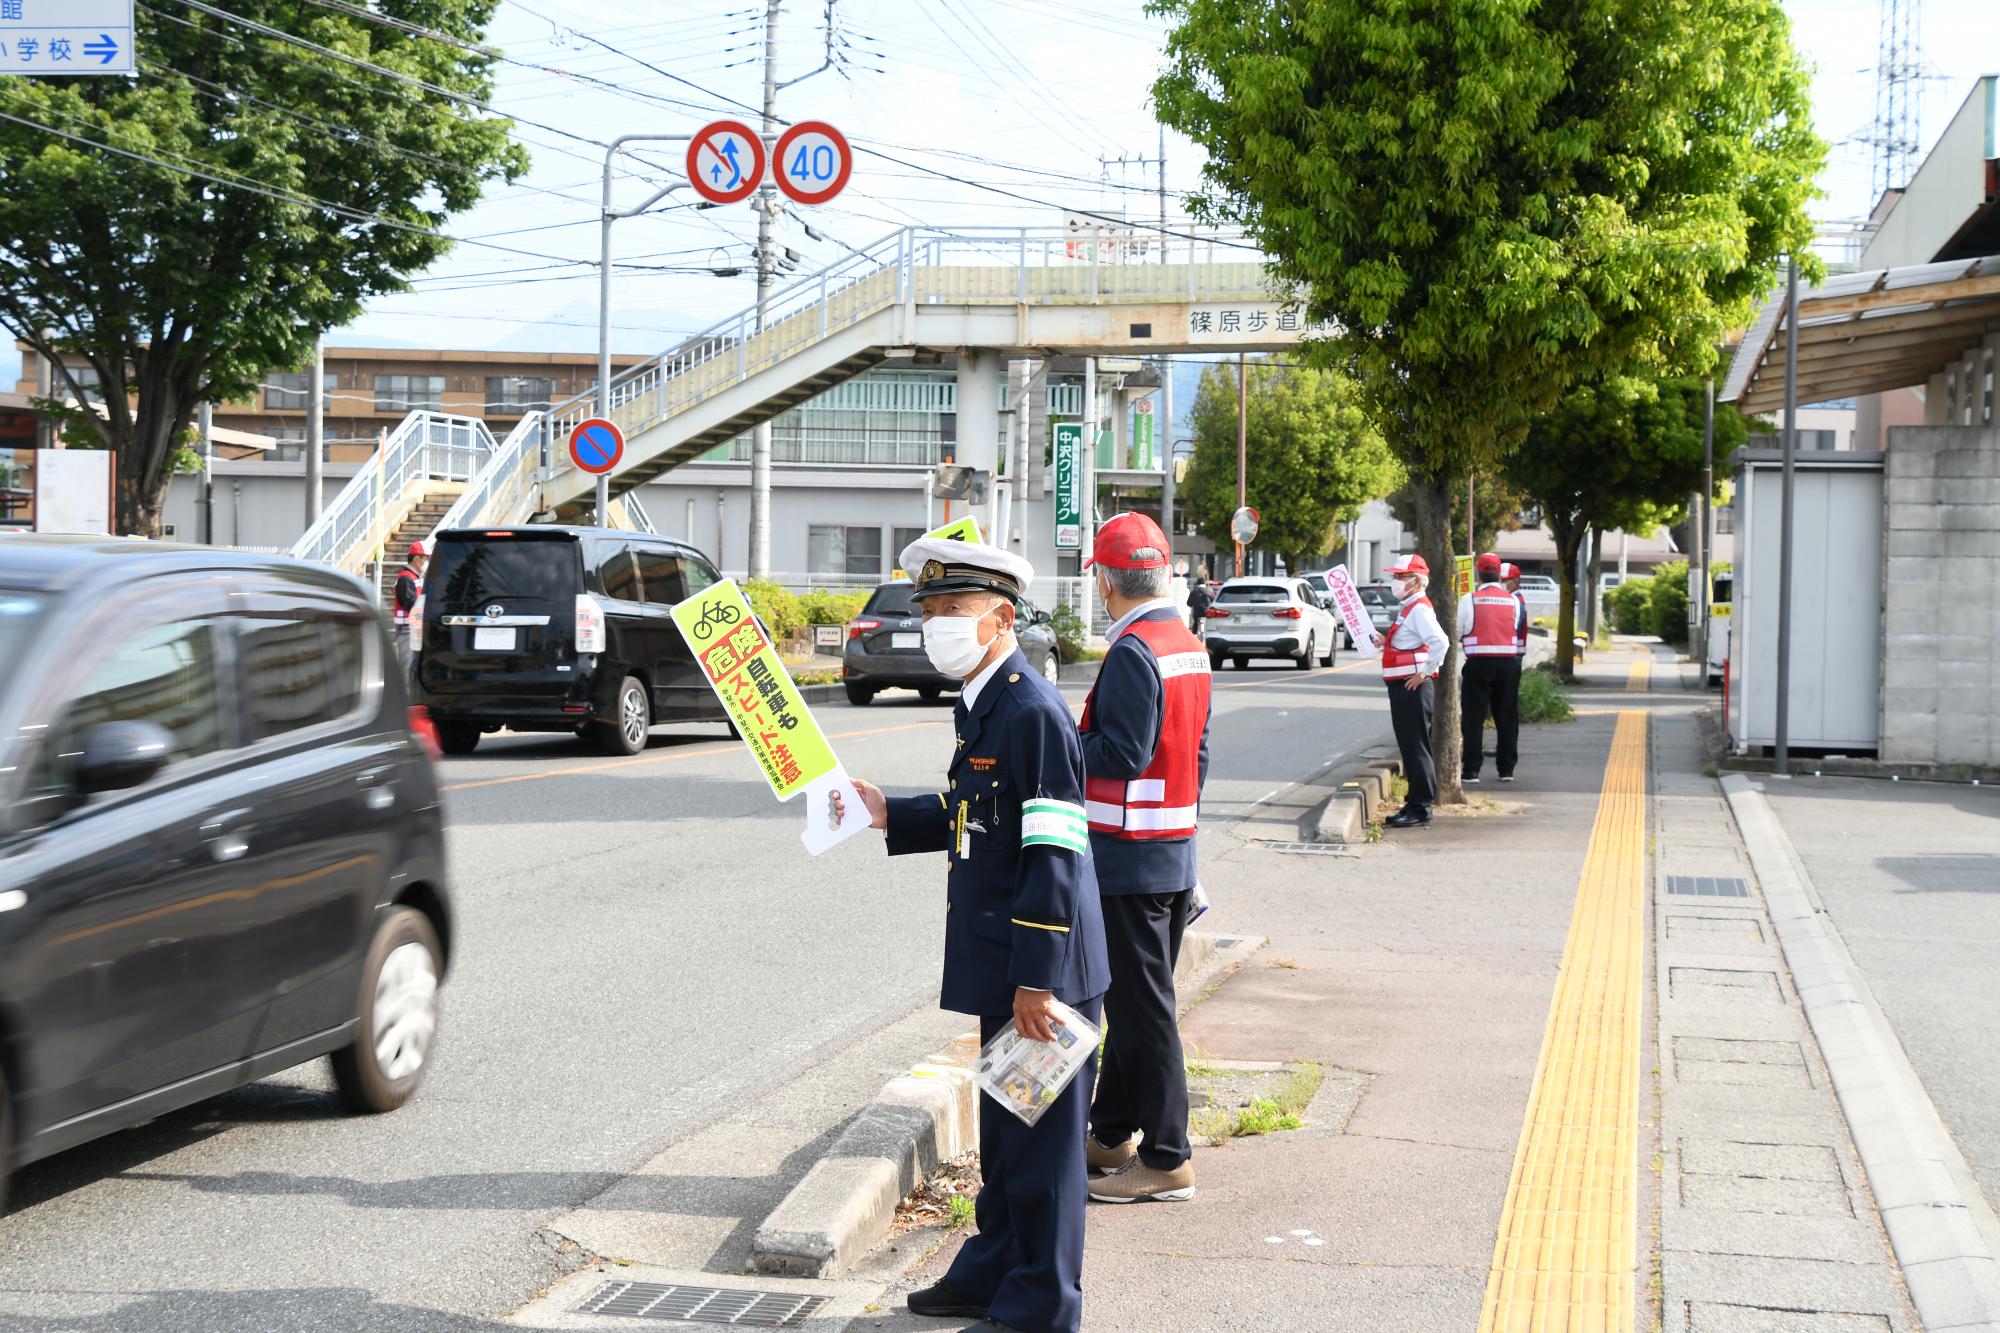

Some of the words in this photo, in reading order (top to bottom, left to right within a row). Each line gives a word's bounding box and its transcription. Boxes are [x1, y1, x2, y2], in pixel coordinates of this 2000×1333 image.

[0, 37, 72, 61] 学校
[791, 145, 834, 180] 40
[1057, 431, 1073, 521] 中沢クリニック
[705, 624, 763, 679] 危険
[746, 657, 799, 731] 自転車も
[728, 672, 803, 786] スピード注意
